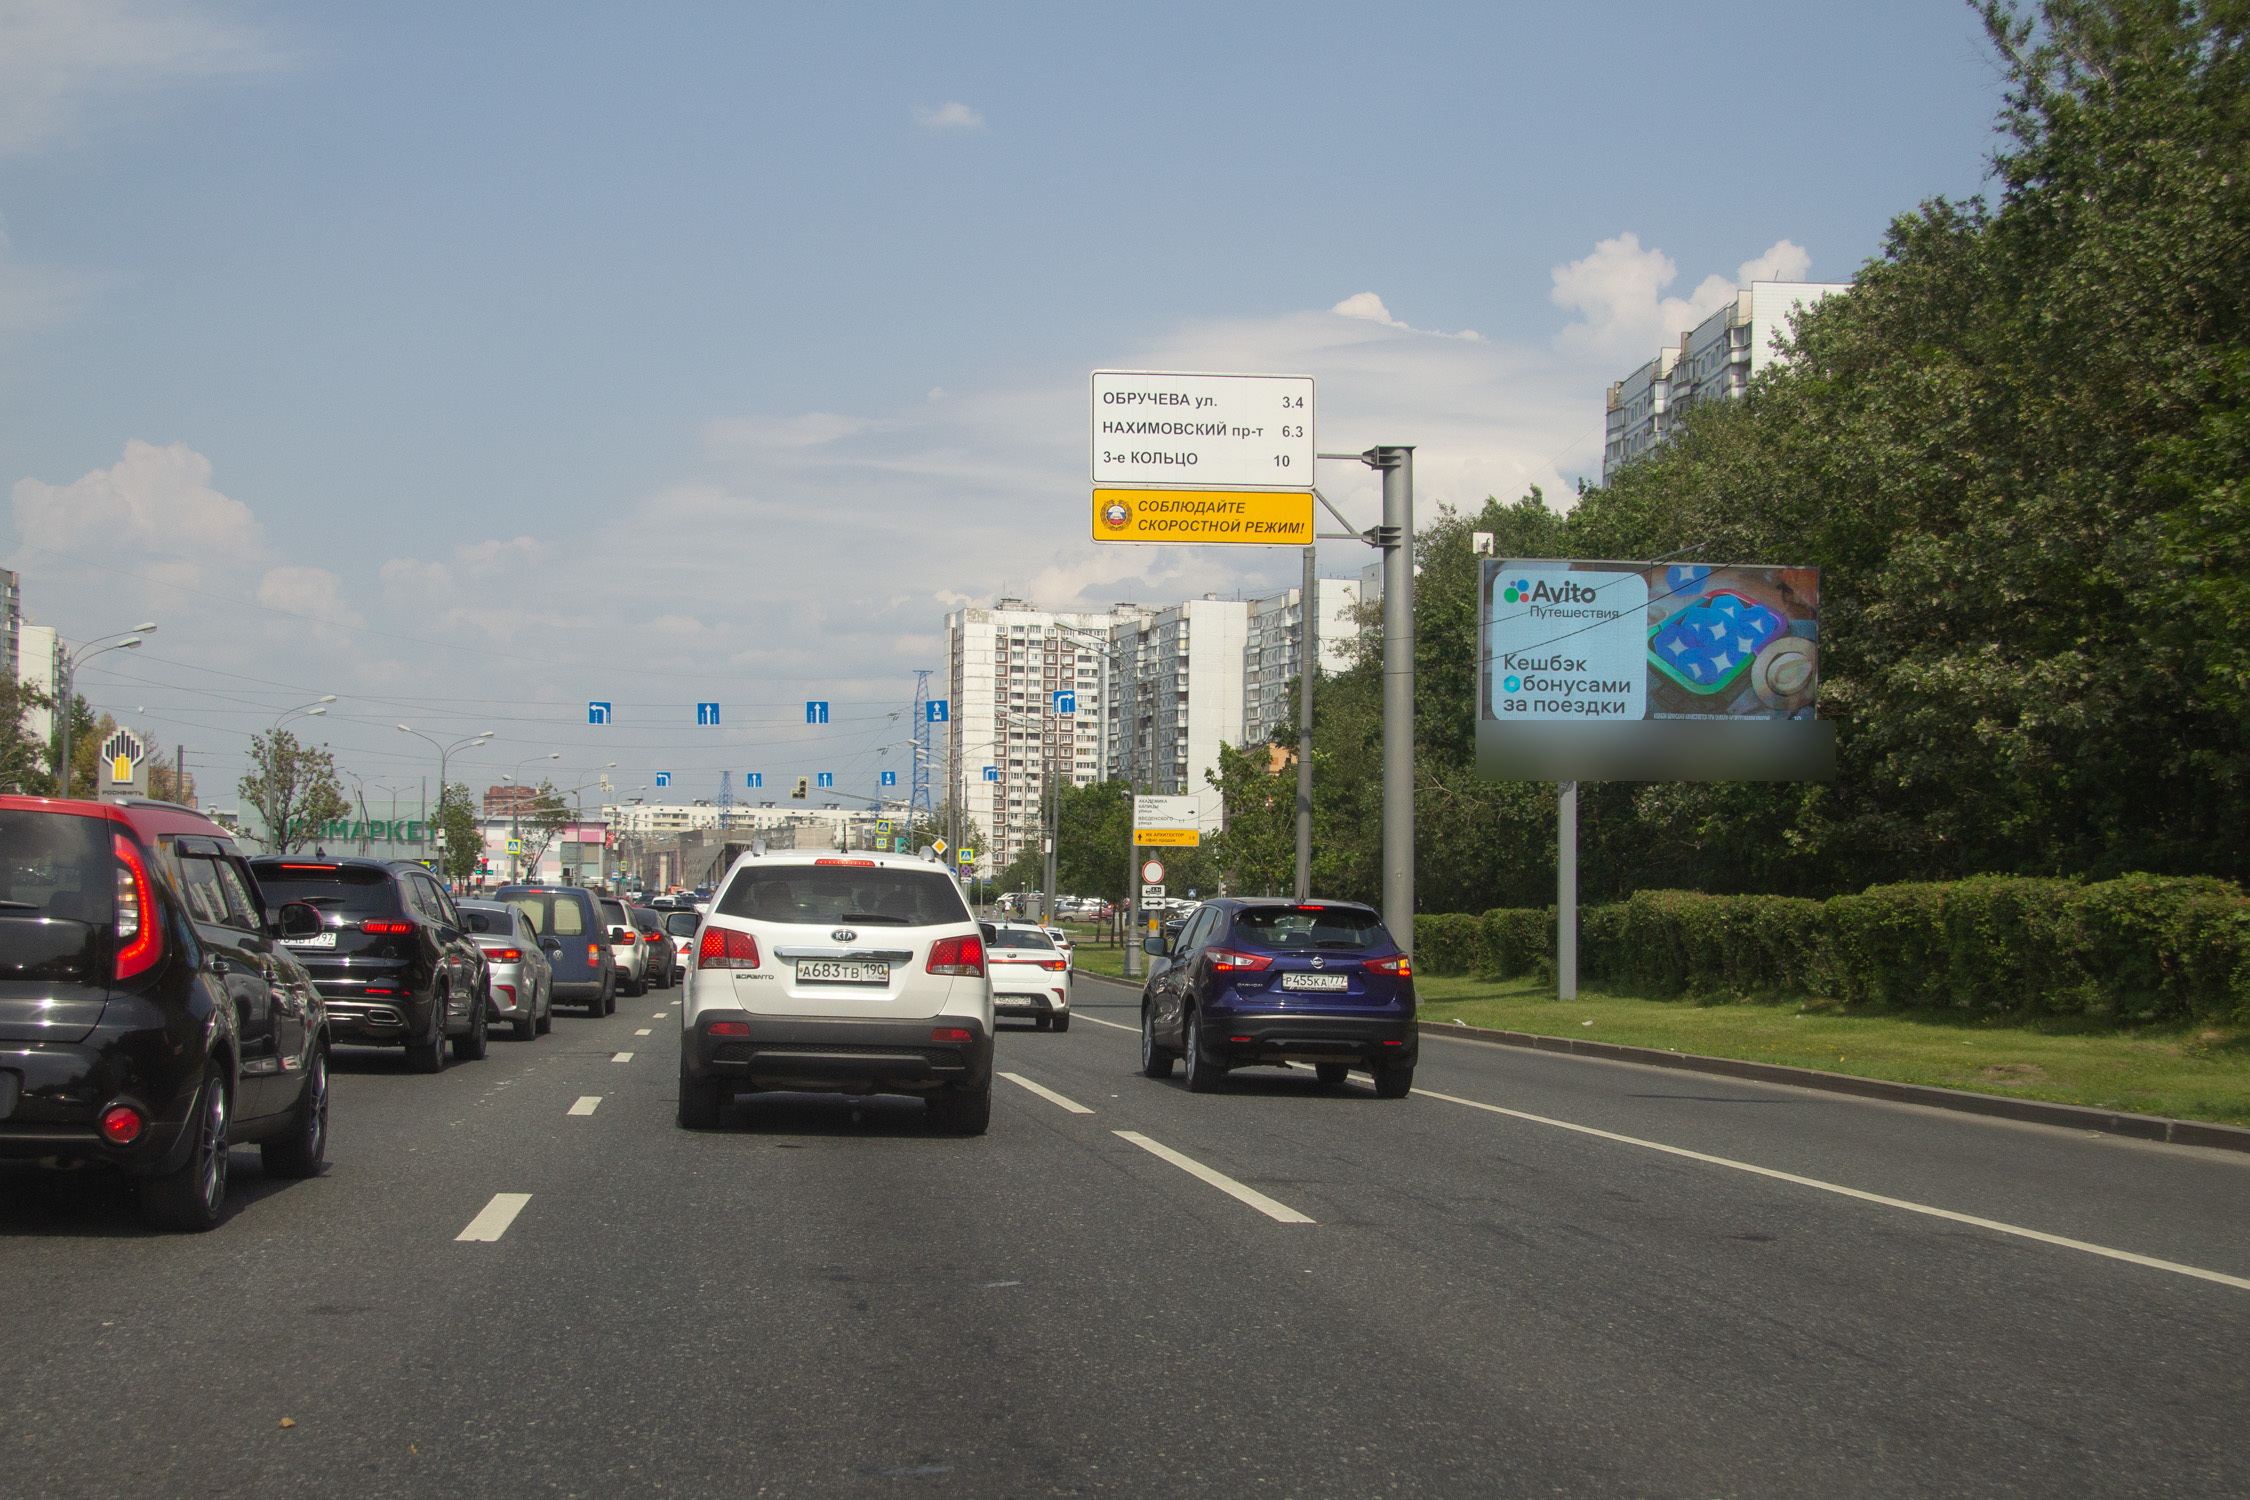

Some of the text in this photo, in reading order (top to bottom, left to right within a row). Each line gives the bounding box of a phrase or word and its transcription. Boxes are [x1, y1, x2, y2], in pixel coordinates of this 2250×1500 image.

[1103, 392, 1304, 409] ОБРУЧЕВА ул. 3.4
[1103, 421, 1304, 439] НАХИМОВСКИЙ пр-т 6.3
[1103, 451, 1290, 467] 3-е КОЛЬЦО 10
[1138, 499, 1246, 515] СОБЛЮДАЙТЕ
[1138, 518, 1305, 534] СКОРОСТНОЙ РЕЖИМ!
[1531, 580, 1596, 603] Avito
[1530, 605, 1619, 620] Путешествия
[1504, 654, 1587, 672] Кешбэк
[1523, 674, 1631, 697] бонусами
[1503, 699, 1625, 716] за поездки
[835, 931, 853, 940] KIA
